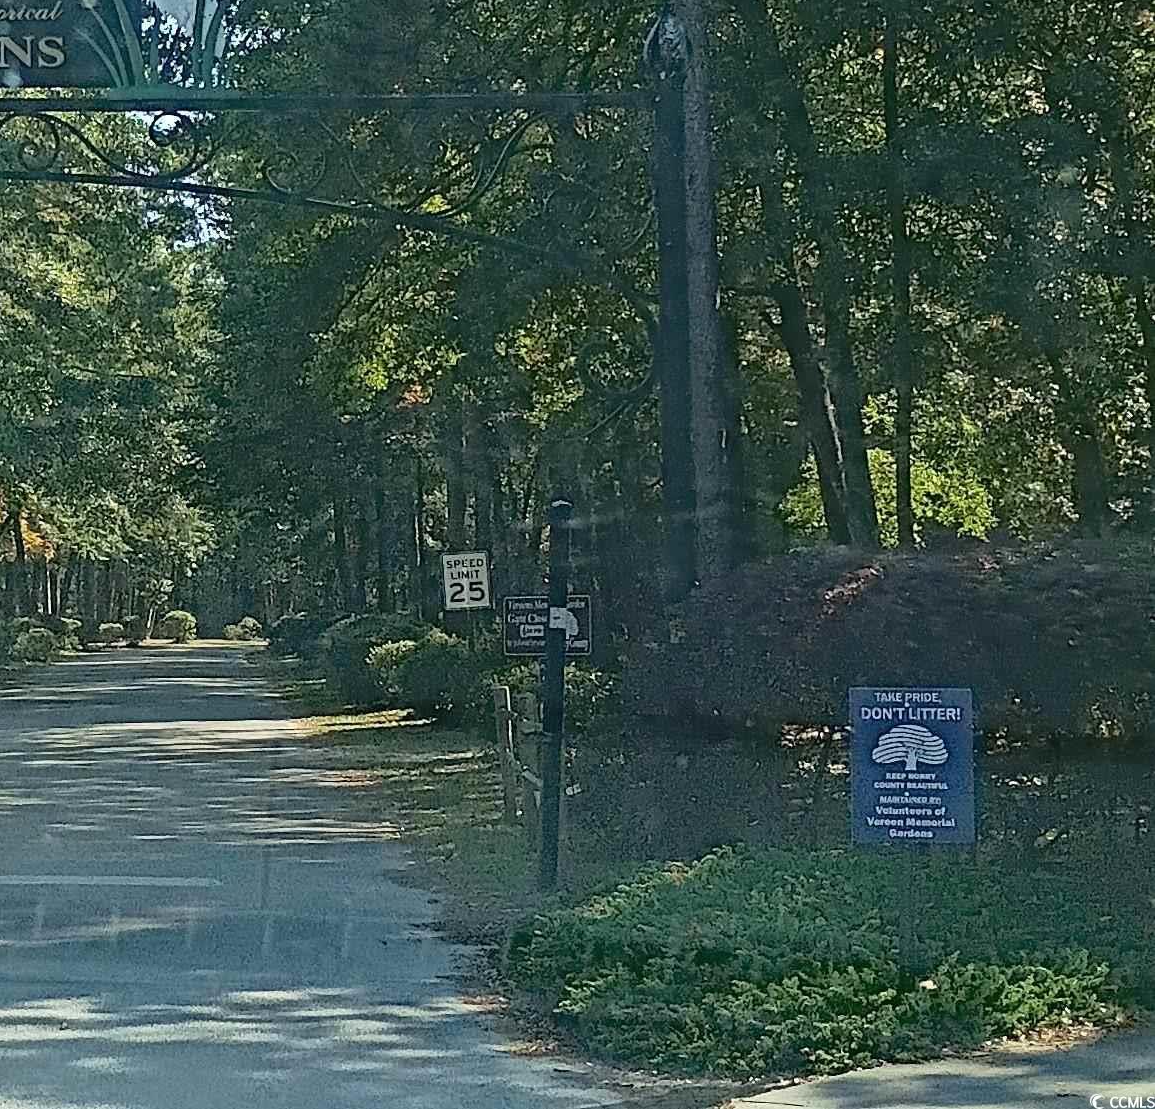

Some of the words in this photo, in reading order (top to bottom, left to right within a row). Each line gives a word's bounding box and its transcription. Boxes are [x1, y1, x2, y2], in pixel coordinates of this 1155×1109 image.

[446, 559, 484, 569] SPEED
[450, 570, 480, 580] LIMIT
[449, 581, 486, 603] 25
[874, 692, 902, 702] TAKE
[861, 707, 906, 720] DON'T
[908, 707, 961, 720] LITTER!
[876, 806, 932, 815] Volunteers
[934, 806, 946, 816] of
[867, 817, 904, 826] Vereen
[905, 818, 955, 827] Memorial
[889, 828, 933, 838] Gardens
